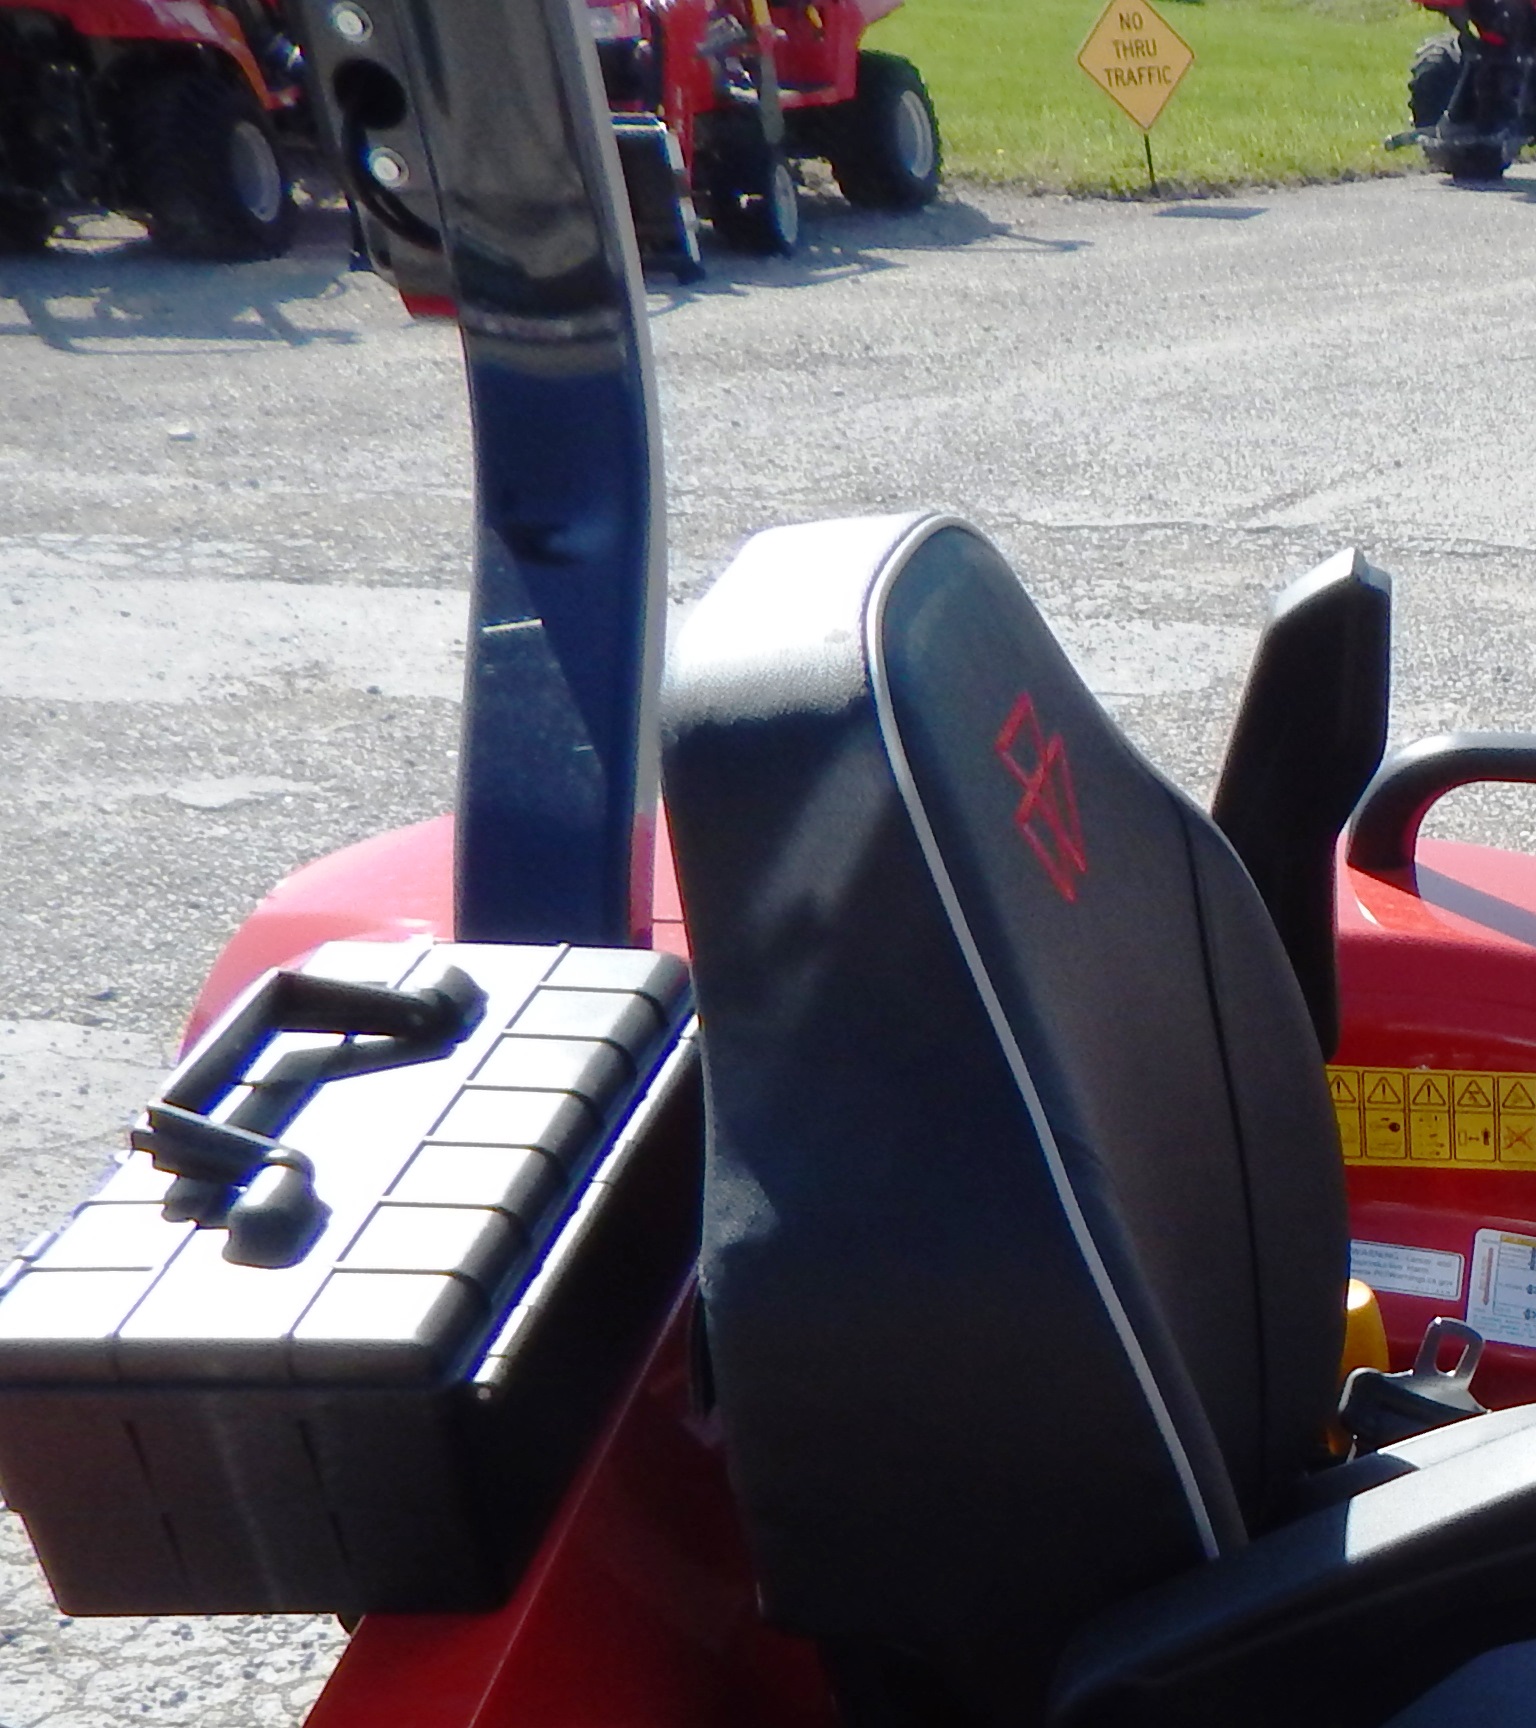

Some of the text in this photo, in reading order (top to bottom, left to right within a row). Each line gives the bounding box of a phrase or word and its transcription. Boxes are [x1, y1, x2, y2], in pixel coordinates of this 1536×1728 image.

[1119, 11, 1143, 30] NO
[1112, 38, 1157, 60] THRU
[1104, 65, 1172, 87] TRAFFIC
